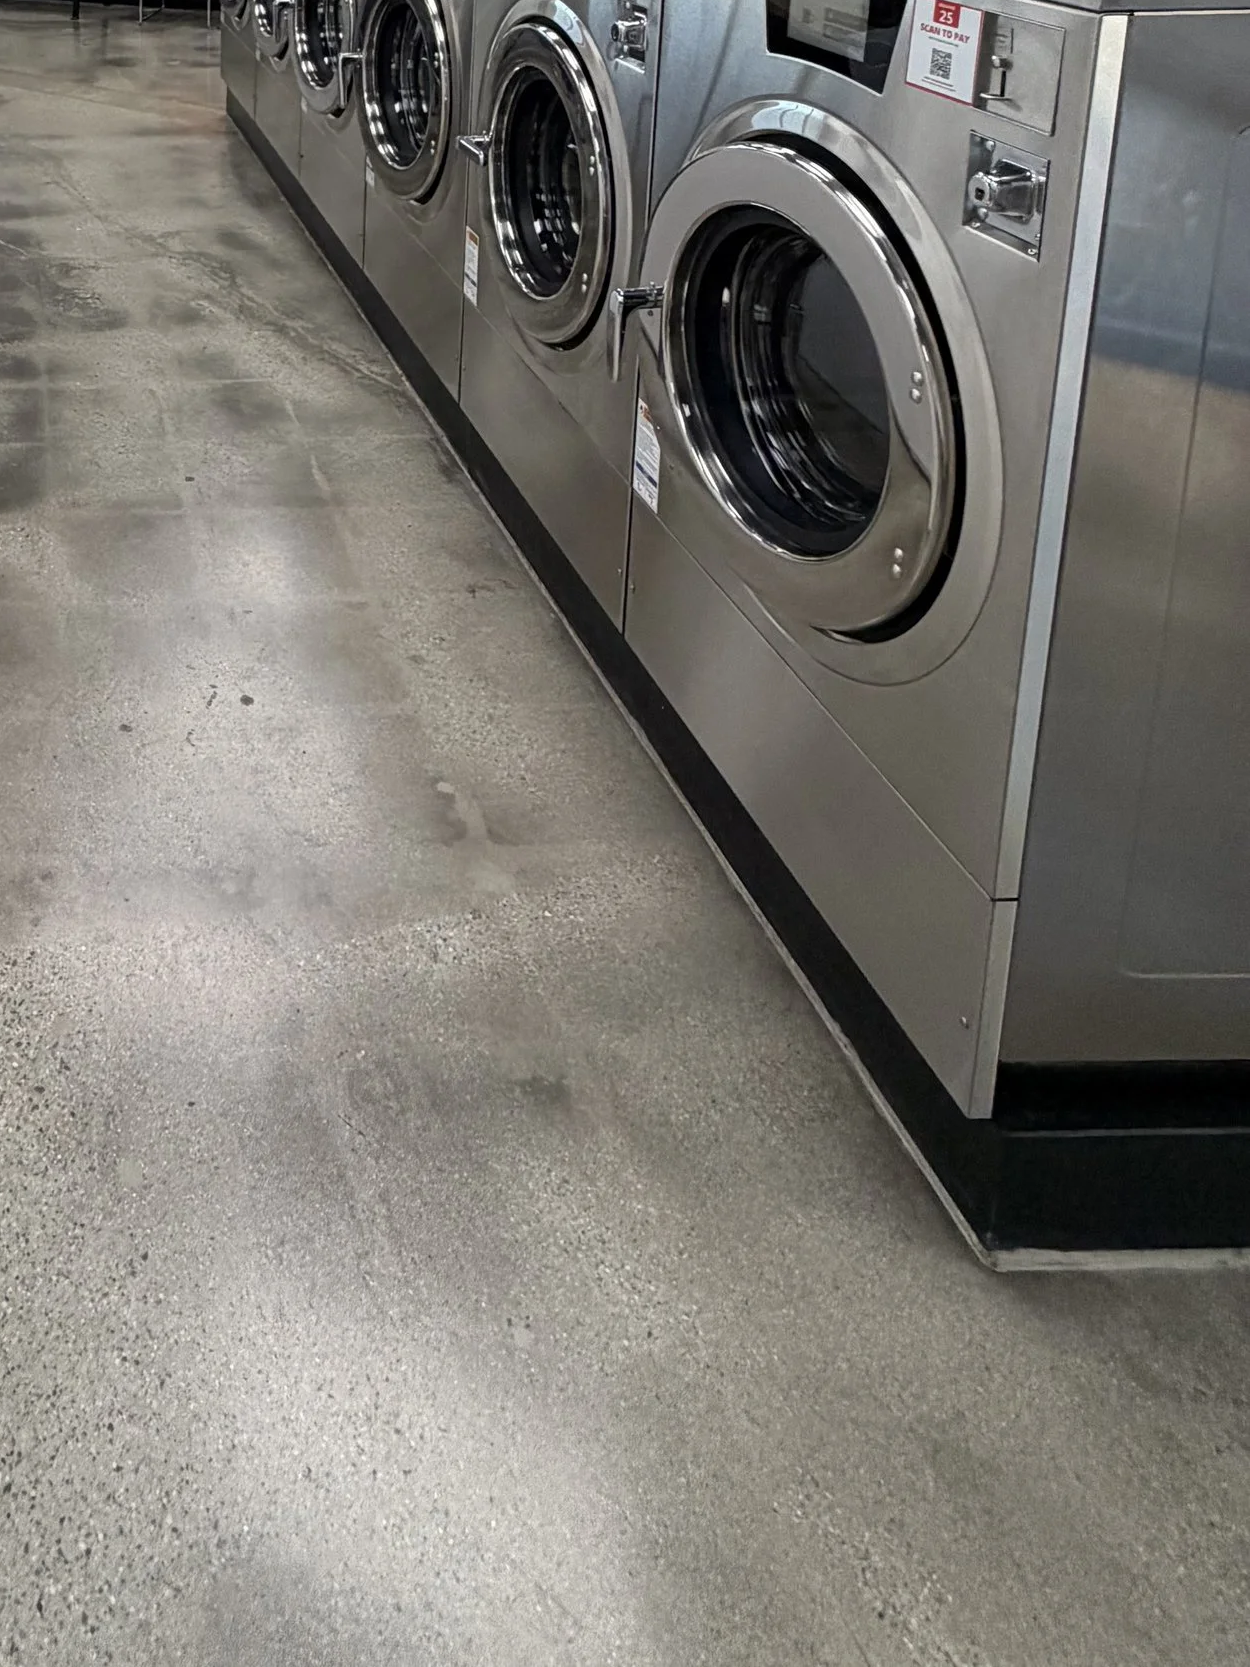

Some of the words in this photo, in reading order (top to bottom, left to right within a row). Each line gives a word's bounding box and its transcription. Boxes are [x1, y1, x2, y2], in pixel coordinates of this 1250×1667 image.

[938, 10, 953, 24] 25
[920, 23, 940, 36] SCAN
[942, 28, 953, 39] TO
[954, 32, 970, 44] PAY
